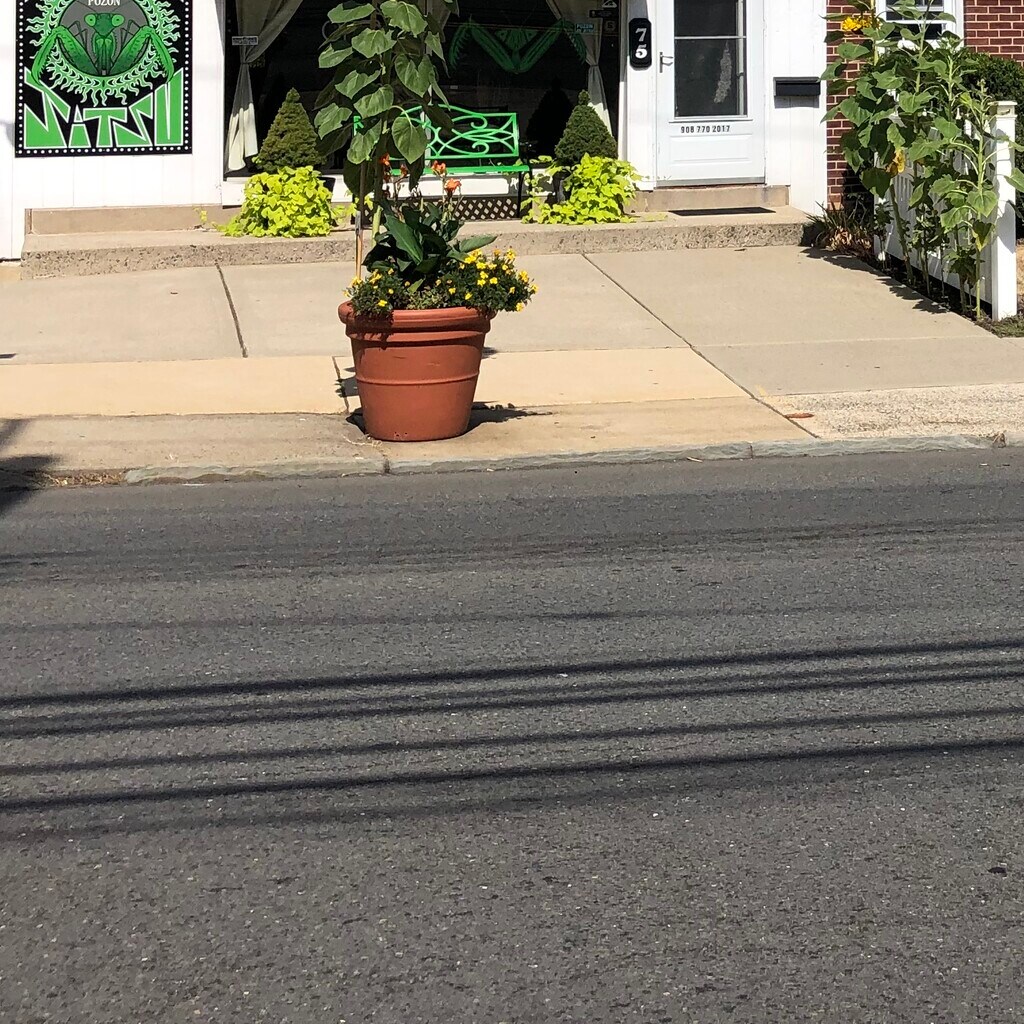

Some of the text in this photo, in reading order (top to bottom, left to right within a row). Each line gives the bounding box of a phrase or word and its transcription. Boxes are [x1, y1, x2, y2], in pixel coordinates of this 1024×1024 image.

[680, 125, 731, 134] 908 770 2017
